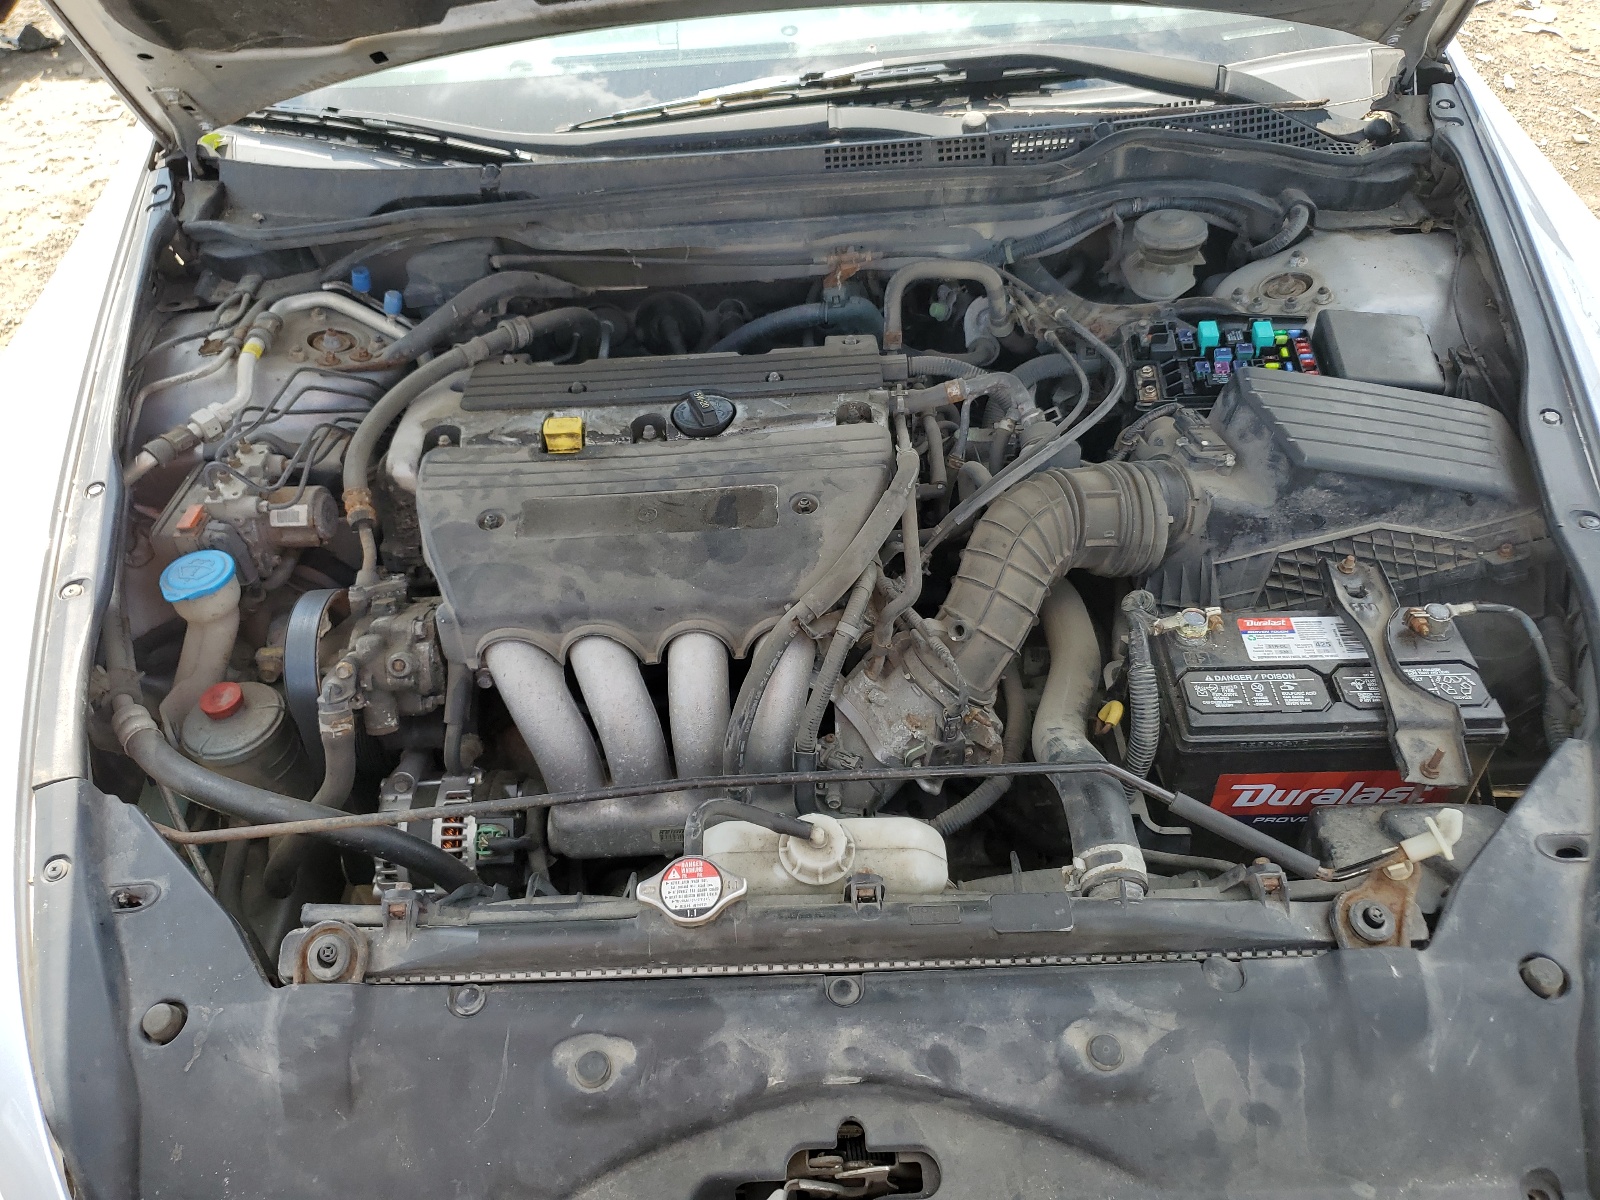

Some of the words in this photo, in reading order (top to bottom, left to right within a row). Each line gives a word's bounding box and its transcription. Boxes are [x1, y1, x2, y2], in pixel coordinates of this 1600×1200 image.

[693, 391, 711, 409] 5W-20
[1244, 619, 1286, 627] Duralast
[1214, 674, 1253, 682] DANGER
[687, 908, 697, 917] 1.1
